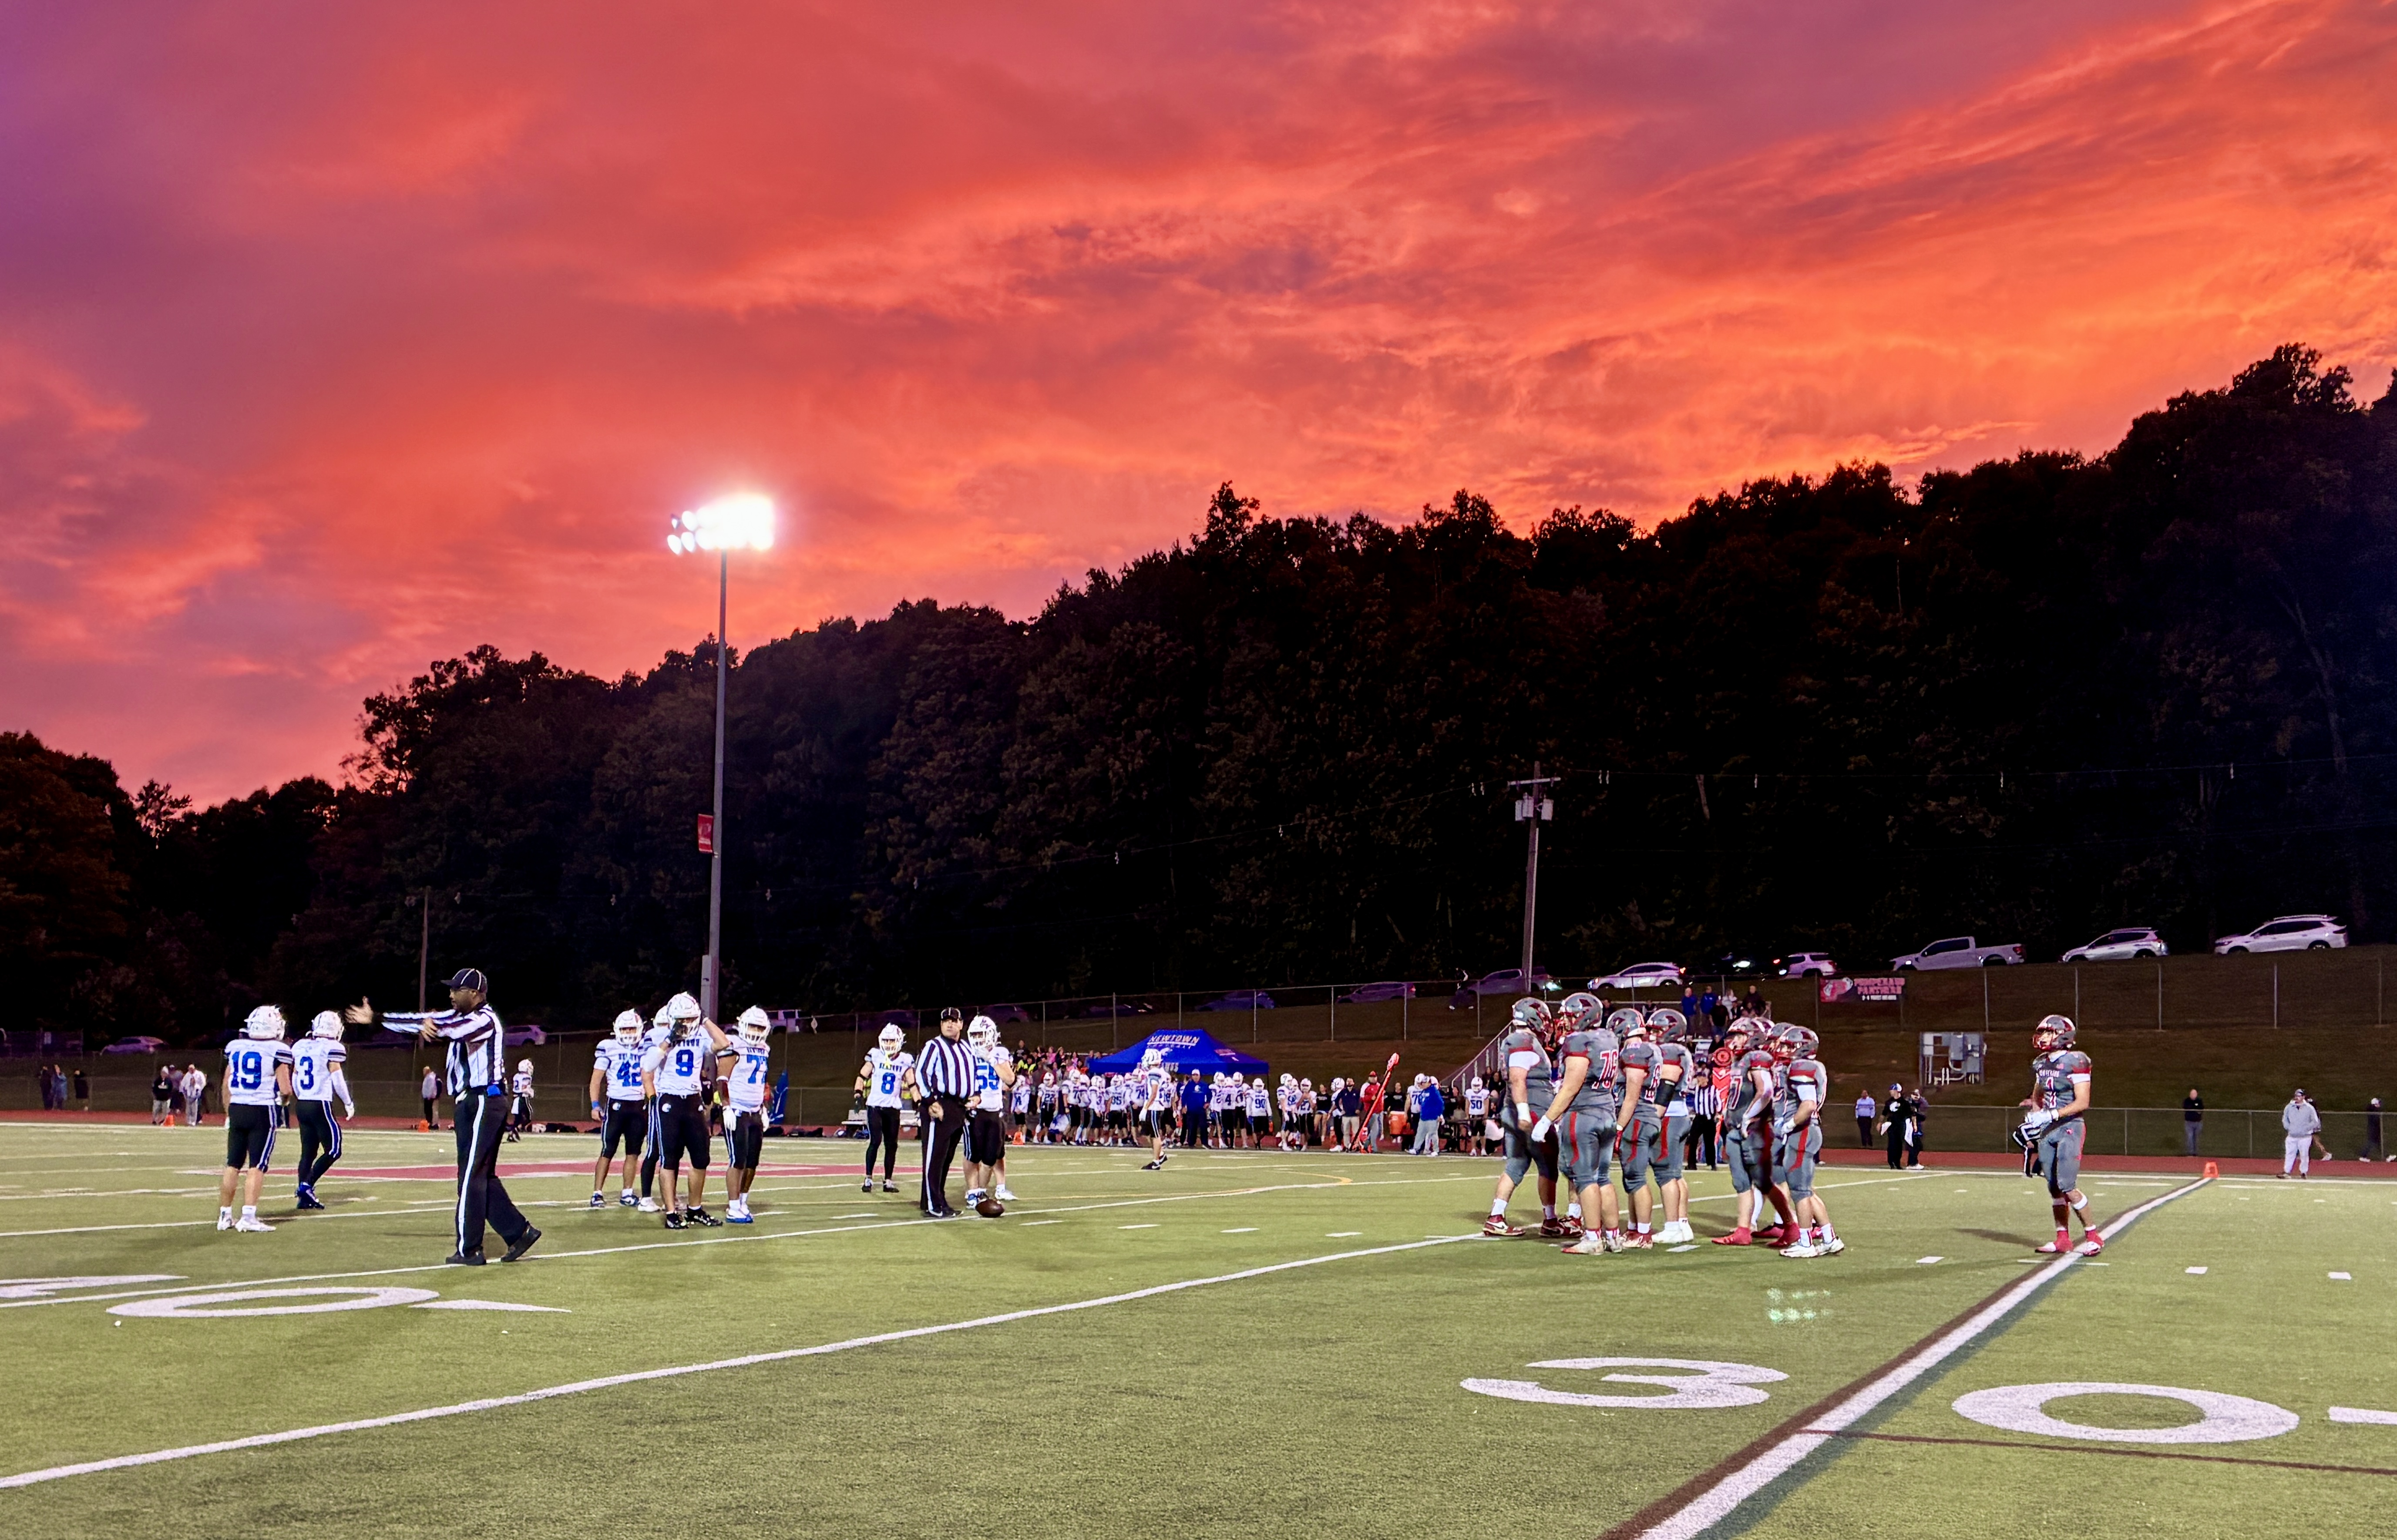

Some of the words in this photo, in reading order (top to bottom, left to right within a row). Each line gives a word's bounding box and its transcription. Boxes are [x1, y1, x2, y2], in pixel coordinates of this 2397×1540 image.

[1148, 1035, 1200, 1044] NEWTOWN
[231, 1051, 262, 1090] 19
[300, 1056, 314, 1090] 3
[616, 1060, 642, 1086] 42
[676, 1049, 694, 1077] 9
[881, 1072, 896, 1094] 8
[1470, 1100, 1482, 1110] 50
